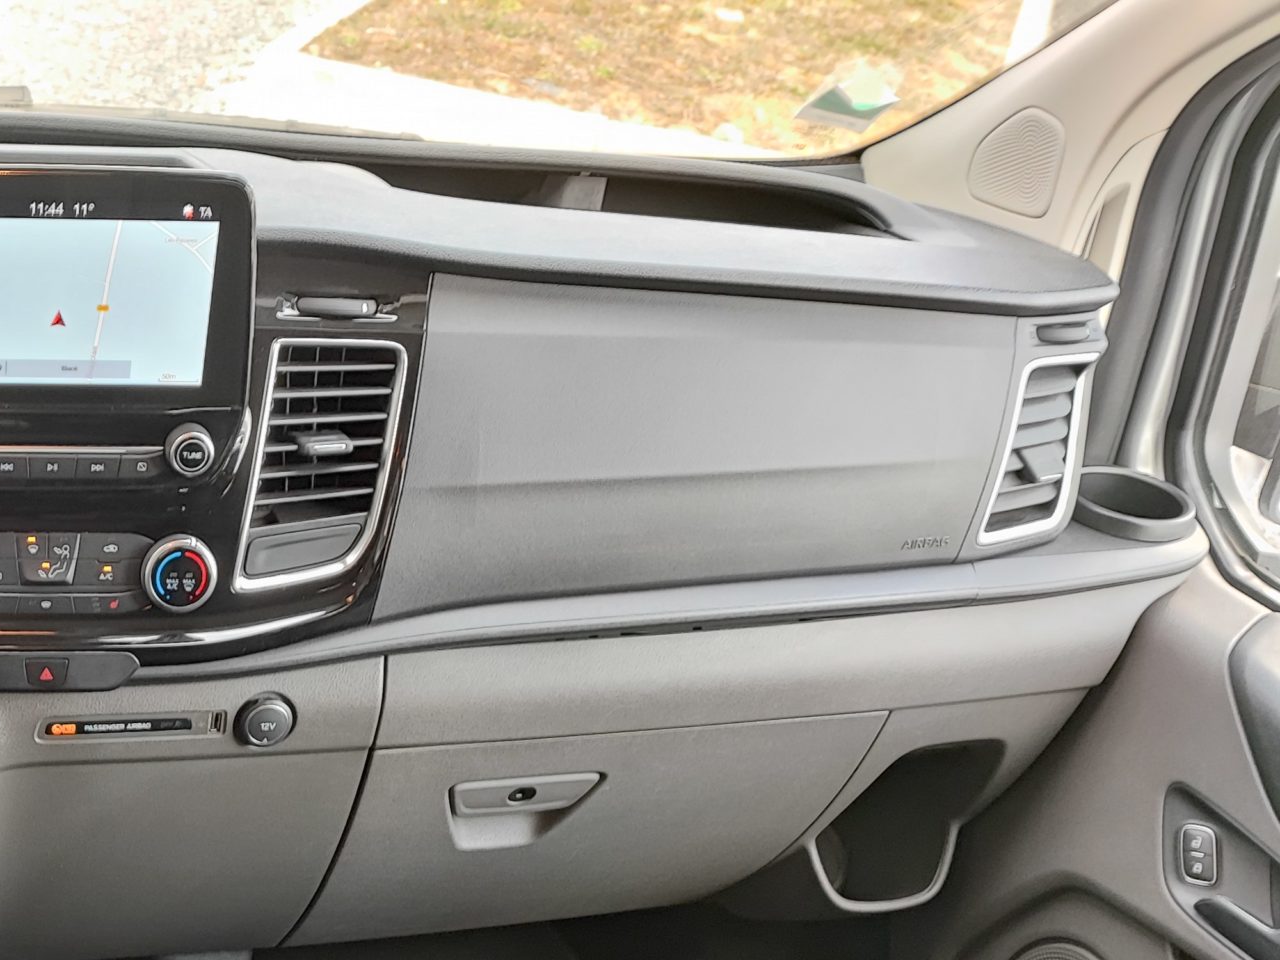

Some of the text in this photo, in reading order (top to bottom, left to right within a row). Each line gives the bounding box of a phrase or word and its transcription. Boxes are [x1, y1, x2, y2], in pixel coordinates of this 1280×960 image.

[29, 201, 64, 217] 11:44
[198, 206, 213, 219] TA
[182, 451, 203, 460] TUNE
[99, 573, 113, 581] A/C
[84, 723, 126, 732] PASSENGER
[126, 721, 152, 730] AIRBAG
[259, 722, 277, 732] 12V
